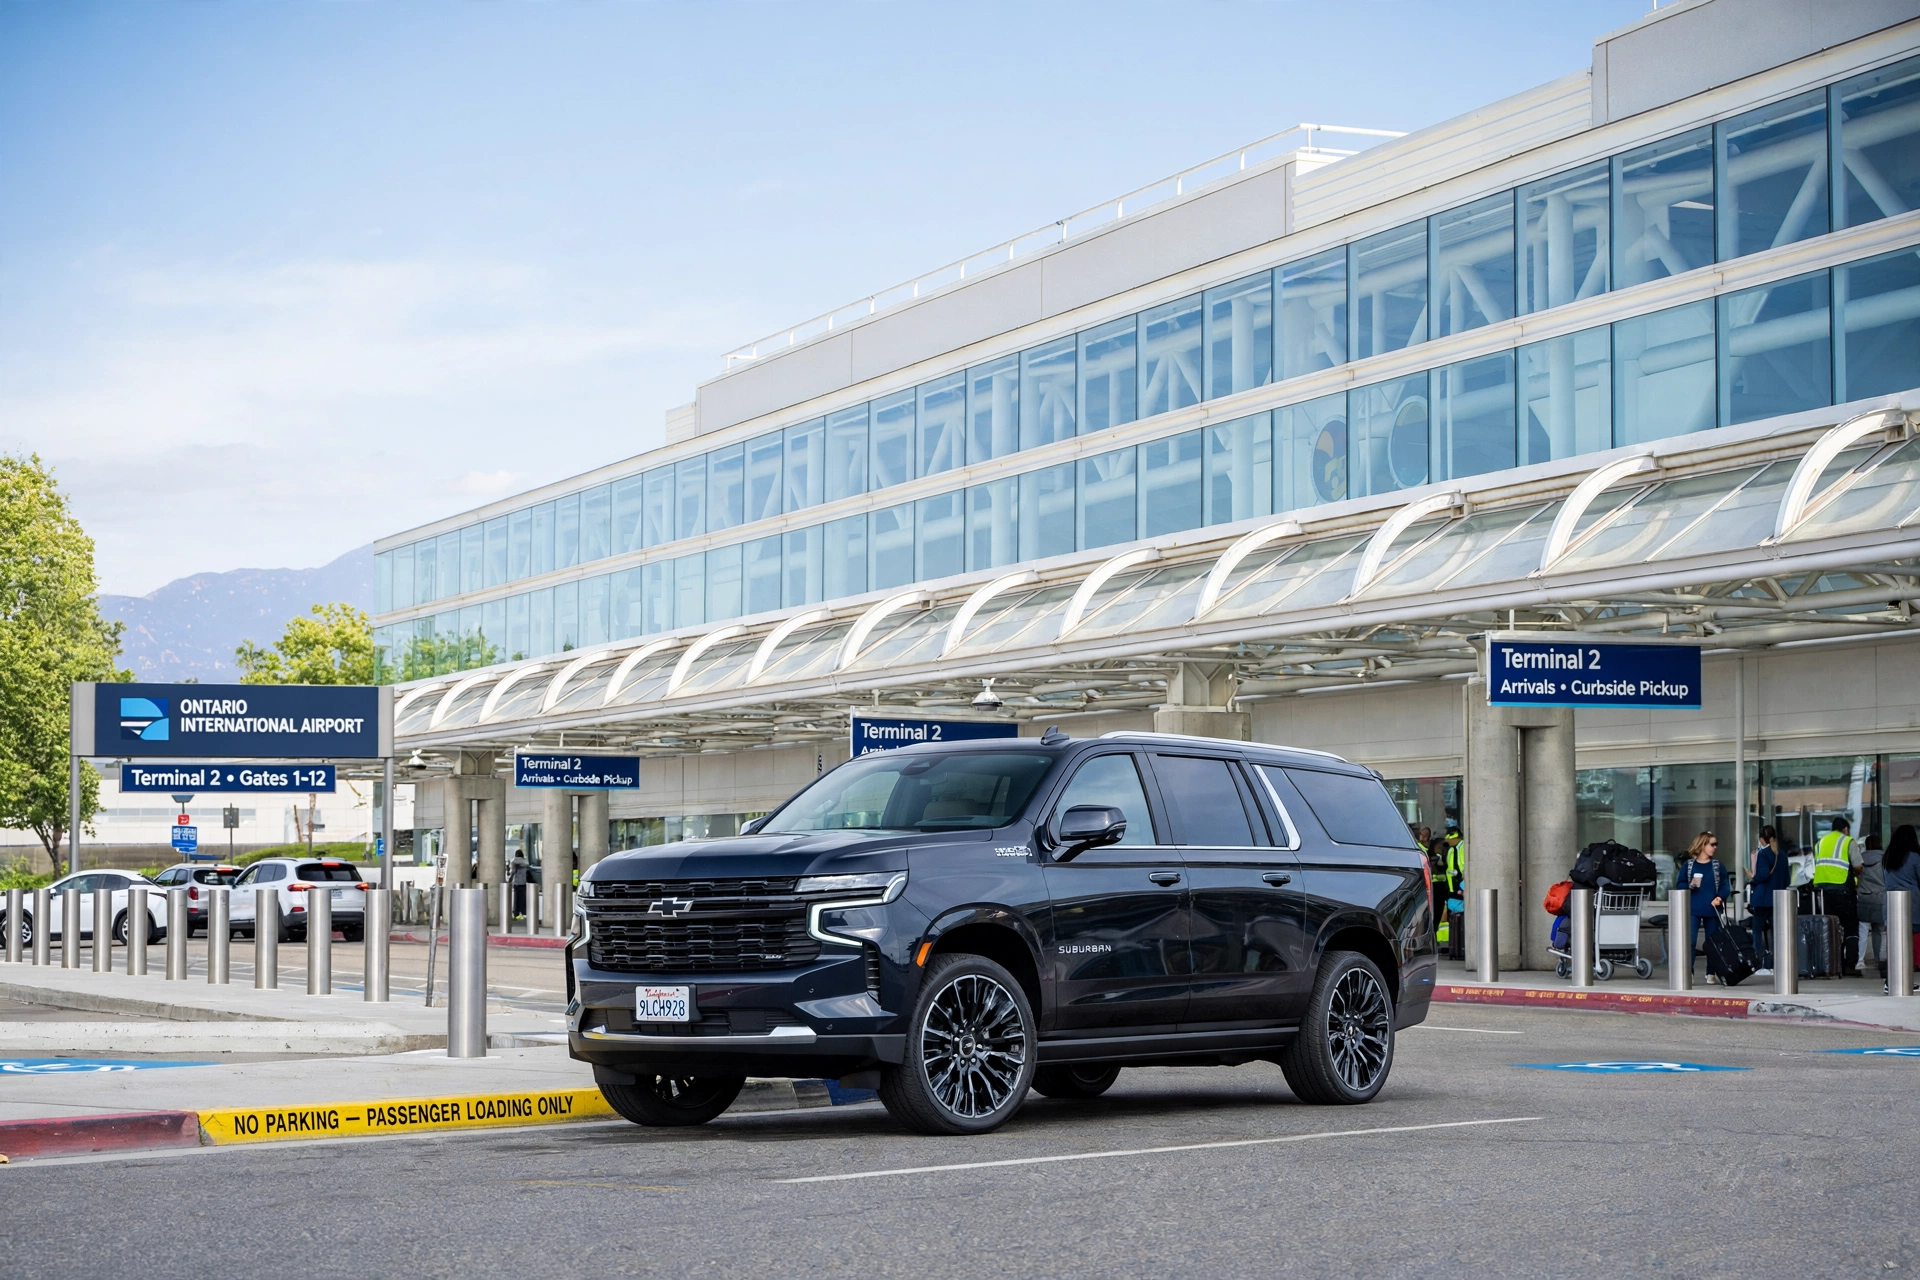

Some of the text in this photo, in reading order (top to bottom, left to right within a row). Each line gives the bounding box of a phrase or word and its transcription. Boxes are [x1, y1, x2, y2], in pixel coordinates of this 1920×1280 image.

[1501, 648, 1601, 670] Terminal 2
[1500, 678, 1556, 695] Arrivals
[1571, 679, 1636, 696] Curbside
[1640, 680, 1689, 699] Pickup
[180, 699, 248, 715] ONTARIO
[180, 717, 364, 733] INTERNATIONAL AIRPORT
[860, 722, 942, 741] Terminal 2
[521, 757, 582, 770] Terminal 2
[131, 768, 205, 786] Terminal
[209, 769, 221, 786] 2
[239, 769, 288, 787] Gates
[292, 770, 326, 787] 1-12
[521, 773, 555, 783] Arrivals
[1058, 944, 1112, 953] SUBURBAN
[639, 999, 686, 1017] 9LCH928
[234, 1114, 259, 1135] NO
[265, 1110, 339, 1133] PARKING
[367, 1103, 461, 1126] PASSENGER
[466, 1097, 533, 1120] LOADING
[537, 1095, 574, 1115] ONLY
